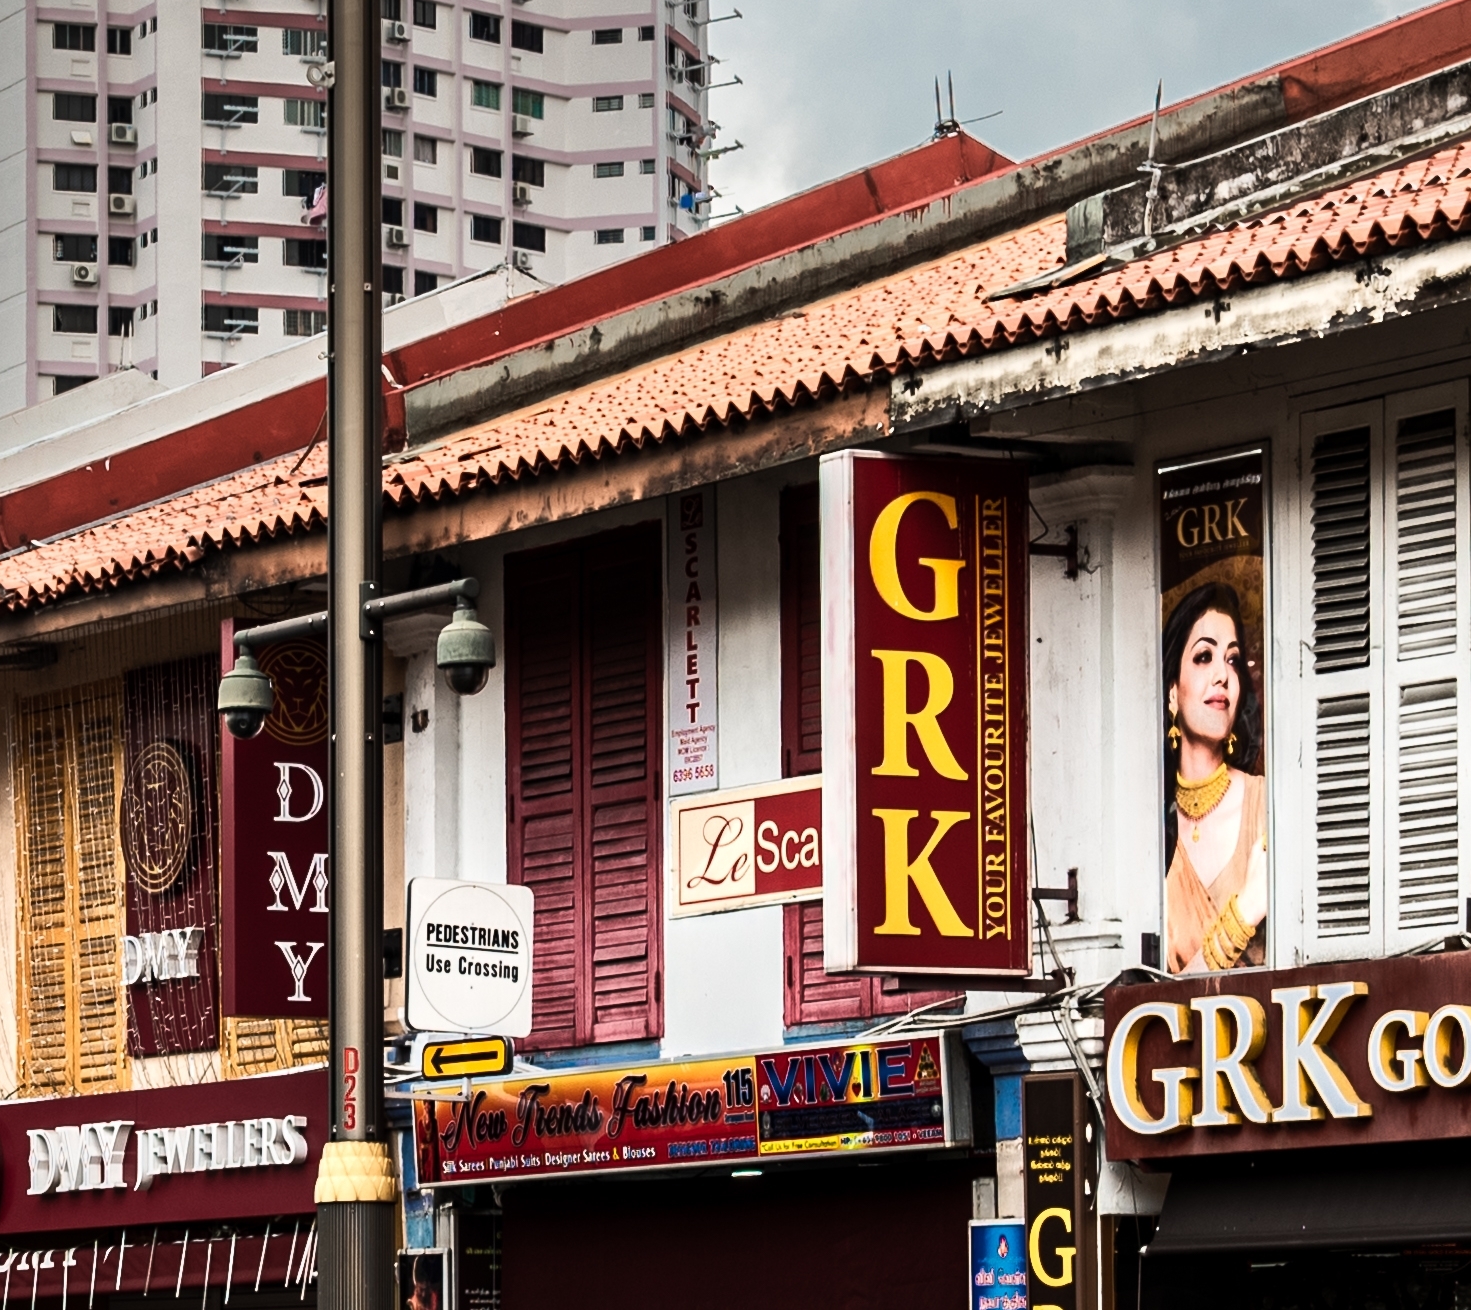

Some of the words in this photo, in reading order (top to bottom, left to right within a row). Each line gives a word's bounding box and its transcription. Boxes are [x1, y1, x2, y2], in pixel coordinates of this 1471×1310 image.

[1177, 497, 1249, 548] GRK
[982, 497, 1004, 666] JEWELLER
[684, 532, 702, 724] SCARLETT
[869, 491, 974, 937] GRK
[984, 673, 1005, 847] FAVOURITE
[266, 762, 329, 1002] DMY
[985, 856, 1005, 941] YOUR
[120, 926, 204, 986] DMY
[426, 953, 451, 973] Use
[458, 956, 519, 983] Crossing
[427, 923, 519, 949] PEDESTRIANS
[342, 1047, 360, 1130] D23
[760, 1042, 916, 1107] VIVIE
[1106, 980, 1373, 1135] GRK
[440, 1091, 507, 1152] New
[511, 1083, 603, 1145] Trends
[607, 1073, 721, 1139] Fashion
[723, 1068, 754, 1108] 115
[26, 1119, 135, 1195] DMY
[134, 1114, 308, 1191] JEWELLERS
[459, 1157, 485, 1172] Sarees
[489, 1155, 519, 1172] Punjabi
[520, 1153, 541, 1168] Suits
[545, 1149, 581, 1168] Designer
[582, 1147, 611, 1163] Sarees
[612, 1148, 620, 1161] &
[623, 1145, 656, 1160] Blouses
